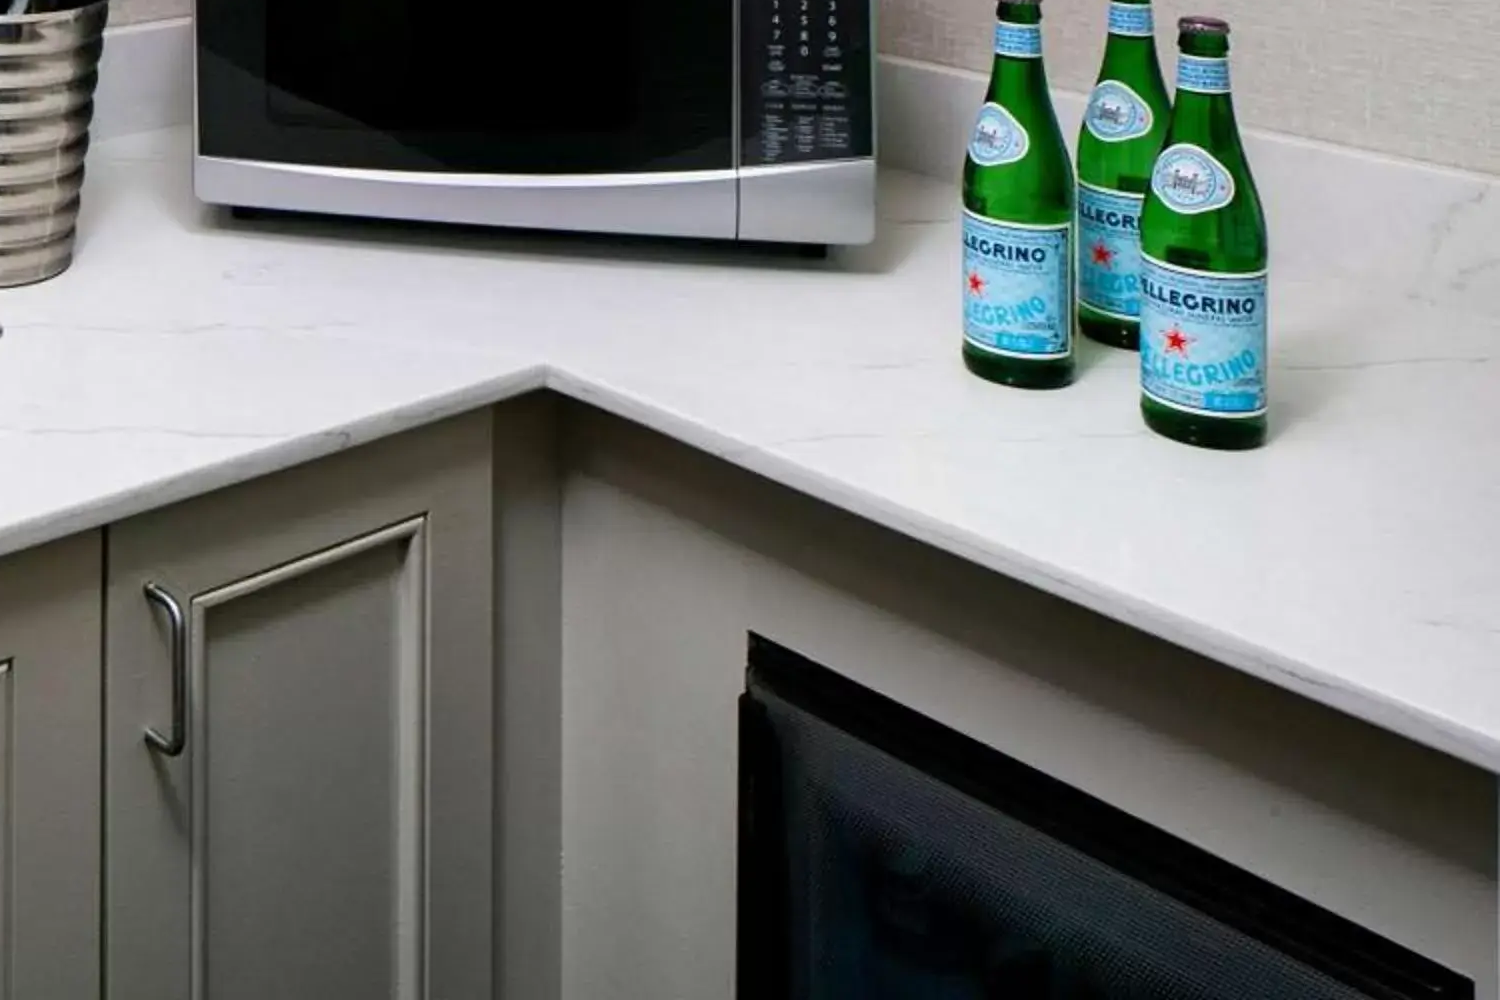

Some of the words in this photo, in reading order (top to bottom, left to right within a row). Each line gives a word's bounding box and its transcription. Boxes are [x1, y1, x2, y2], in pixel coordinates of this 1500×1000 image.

[773, 0, 779, 9] 1
[800, 0, 807, 11] 2
[829, 0, 836, 11] 3
[772, 15, 779, 24] 4
[800, 15, 808, 25] 5
[828, 15, 836, 26] 6
[773, 30, 780, 41] 7
[827, 31, 836, 41] 9
[800, 45, 809, 57] 0
